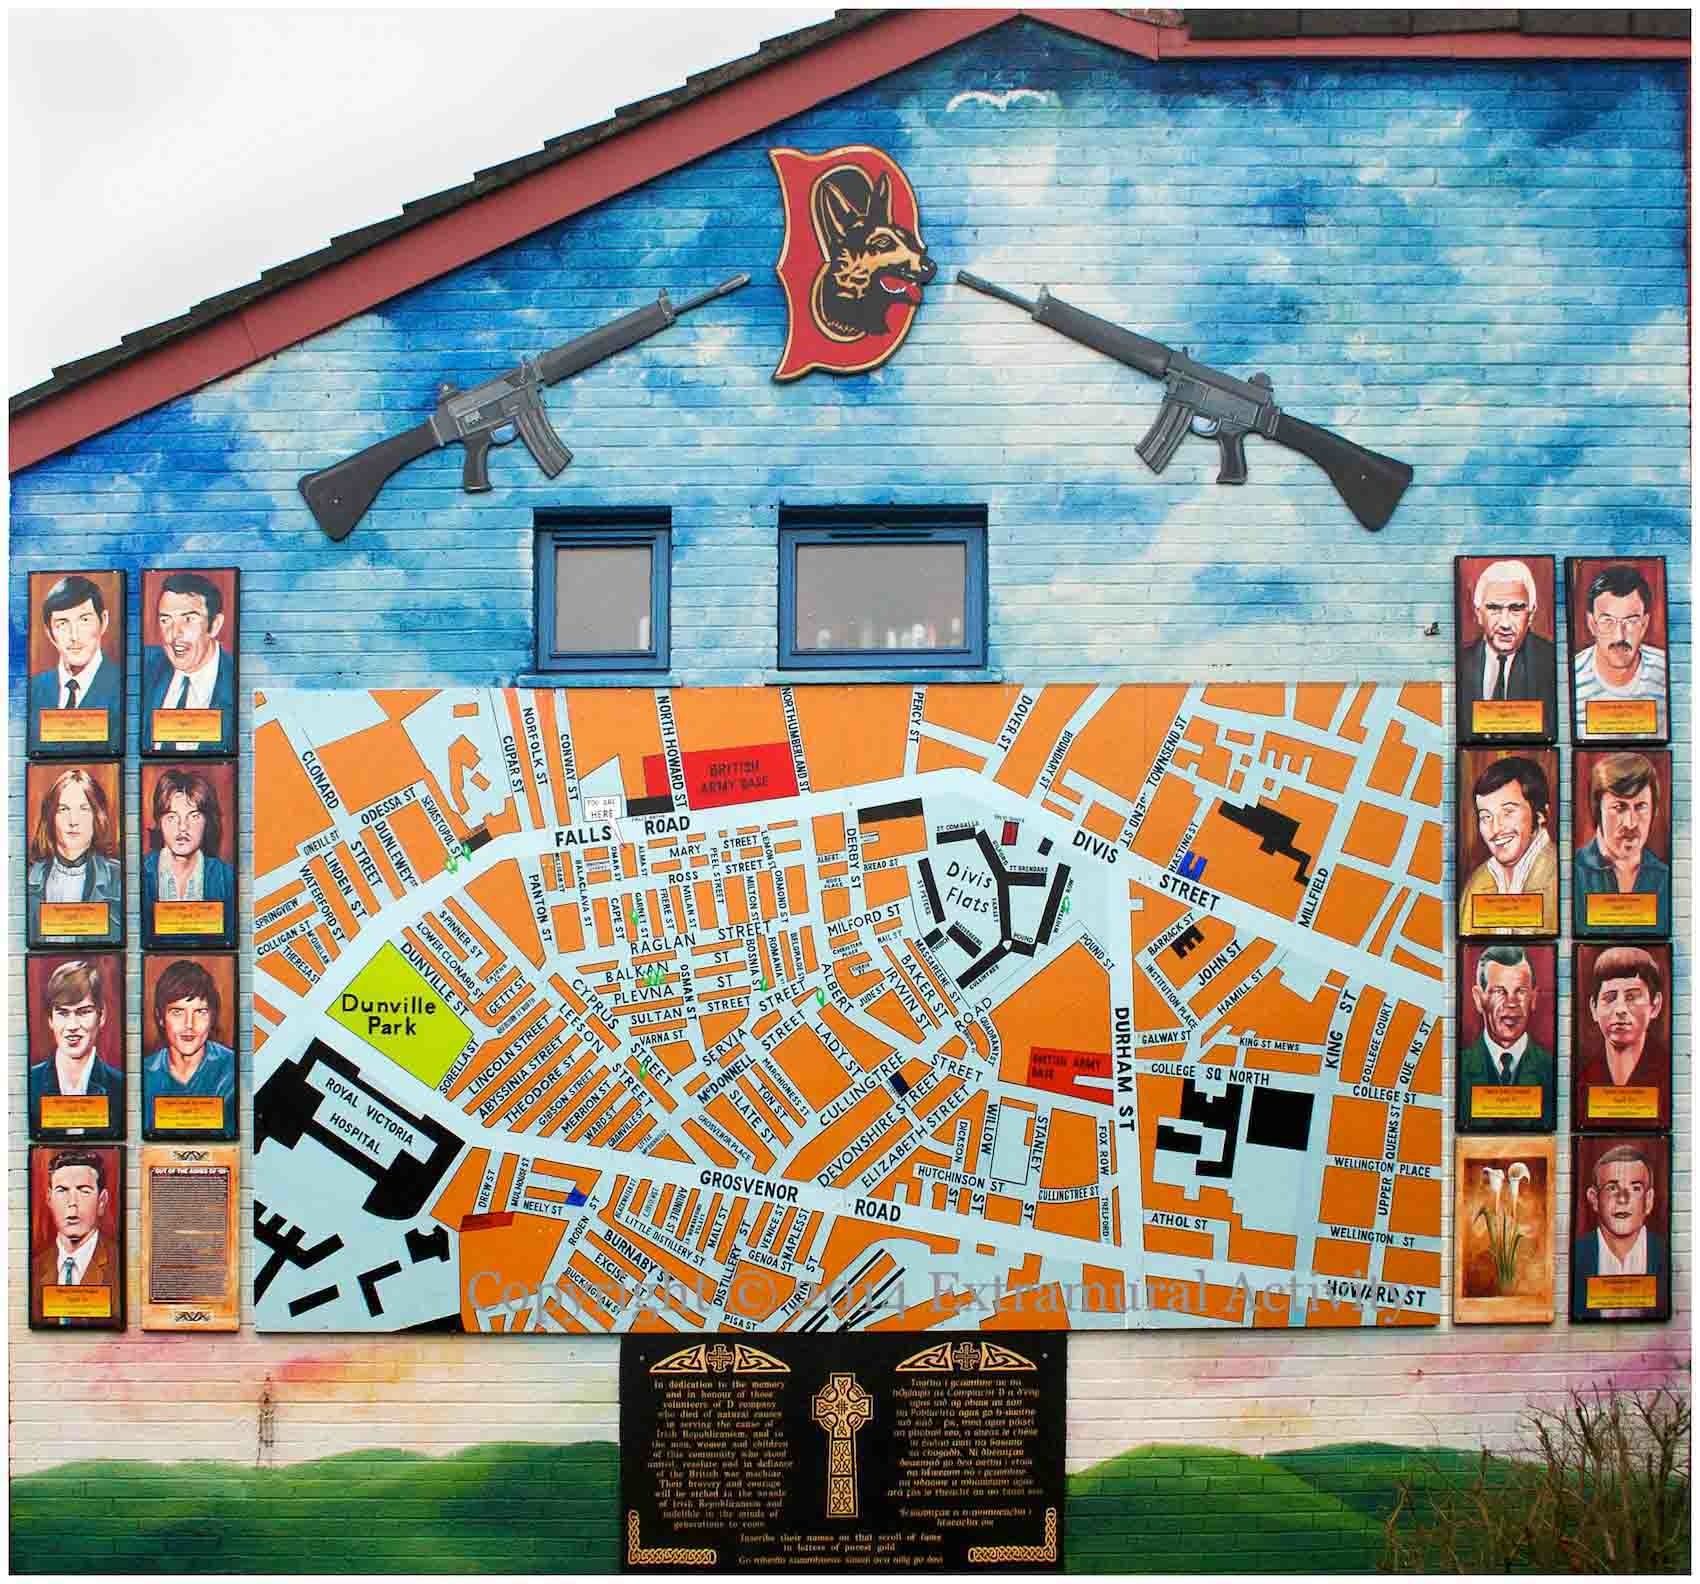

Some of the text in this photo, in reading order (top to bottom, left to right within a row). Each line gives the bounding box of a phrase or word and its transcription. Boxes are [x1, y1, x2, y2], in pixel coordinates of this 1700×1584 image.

[911, 692, 924, 725] PERCY
[1006, 695, 1033, 734] DOVER
[523, 707, 544, 769] NORFOLK
[657, 695, 684, 790] NORTH HOWARD
[782, 688, 808, 779] NORTHUMBERLAND
[1045, 730, 1073, 776] BOUNDARY
[503, 735, 520, 776] CUPAR
[560, 734, 576, 784] CONWAY
[1146, 731, 1180, 788] TOWNSEND
[302, 751, 383, 887] CLONARD STREET
[361, 796, 402, 825] ODESSA
[423, 795, 454, 844] SEVASTOPOL
[374, 821, 413, 882] DUNLEWEY
[555, 816, 690, 847] FALLS ROAD
[669, 835, 758, 858] MARY STREET
[847, 828, 859, 868] DERBY
[324, 852, 367, 918] LINDEN ST
[668, 859, 763, 884] ROSS STREET
[946, 861, 993, 889] Divis
[1072, 830, 1220, 911] DIVIS STREET
[256, 898, 298, 929] SPRINGVIEW
[300, 864, 337, 926] WATERFORD
[529, 874, 547, 924] PANTON
[946, 887, 989, 914] Flats
[1299, 867, 1328, 928] MILLFIELD
[257, 928, 298, 956] COLLIGAN
[440, 911, 471, 945] SPINNER
[630, 921, 770, 955] RAGLAN STREET
[827, 910, 881, 936] MILFORD
[1149, 924, 1184, 955] BARRACK
[416, 922, 475, 990] LOWER CLONARD
[1080, 933, 1107, 961] POUND
[1198, 939, 1242, 986] JOHN ST
[401, 943, 471, 1017] DUNVILLE ST
[606, 962, 669, 983] BALKAN
[680, 964, 694, 1003] OSMAN
[901, 954, 948, 1018] BAKER ST
[342, 993, 436, 1015] Dunville
[614, 986, 674, 1005] PLEVNA
[631, 997, 749, 1025] SULTAN STREET
[884, 967, 931, 1031] IRWIN ST
[1145, 964, 1198, 1030] INSTITUTION PLACE
[1217, 982, 1250, 1015] HAMILL
[368, 1016, 417, 1036] Park
[572, 979, 619, 1029] CYPRUS
[631, 1043, 673, 1087] STREET
[639, 1033, 670, 1046] VARNA
[703, 982, 806, 1066] SERVIA STREET
[762, 1011, 806, 1051] STREET
[822, 963, 854, 1014] ALBERT
[931, 1054, 983, 1082] STREET
[1142, 1033, 1180, 1044] GALWAY
[1325, 989, 1357, 1069] KING ST
[1362, 1002, 1393, 1083] COLLEGE COURT
[469, 1017, 551, 1095] LINCOLN STREET
[559, 1003, 654, 1108] LEESON STREET
[815, 1023, 864, 1078] LADY ST
[820, 997, 992, 1126] CULLINGTREE ROAD
[1239, 1037, 1300, 1051] KING MEWS
[439, 1053, 470, 1094] SORELLA
[479, 1037, 564, 1119] ABYSSINIA STREET
[1114, 1007, 1135, 1131] DURHAM ST
[1151, 1063, 1269, 1086] COLLEGE SQ NORTH
[326, 1077, 413, 1145] ROYAL VICTORIA
[504, 1067, 561, 1124] THEODORE
[561, 1093, 601, 1134] MERRION
[1353, 1085, 1400, 1102] COLLEGE
[330, 1113, 382, 1155] HOSPITAL
[584, 1117, 607, 1141] WARD
[730, 1090, 776, 1143] SLATE ST
[817, 1073, 939, 1187] DEVONSHIRE STREET
[862, 1087, 972, 1189] ELIZABETH STREET
[955, 1121, 968, 1163] DICKSON
[1031, 1115, 1048, 1173] STANLEY
[1098, 1125, 1110, 1176] FOX ROW
[918, 1165, 986, 1189] HUTCHINSON
[971, 1103, 998, 1215] WILLOW ST
[1334, 1156, 1431, 1177] WELLINGTON PLACE
[1378, 1120, 1399, 1216] UPPER QUEENS
[478, 1181, 493, 1208] DREW
[523, 1200, 549, 1214] NEELY
[700, 1170, 901, 1222] GROSVENOR ROAD
[568, 1215, 590, 1247] RODEN
[625, 1215, 692, 1259] LITTLE DISTILLERY
[708, 1221, 724, 1248] MALT
[1151, 1213, 1190, 1228] ATHOL
[1330, 1226, 1393, 1244] WELLINGTON
[594, 1253, 628, 1284] EXCISE
[603, 1230, 658, 1273] BURNABY
[748, 1250, 778, 1268] GENOA
[713, 1246, 742, 1307] DISTILLERY
[1327, 1279, 1426, 1307] HOWARD ST
[781, 1283, 809, 1316] TURIN
[724, 1314, 745, 1327] PISA
